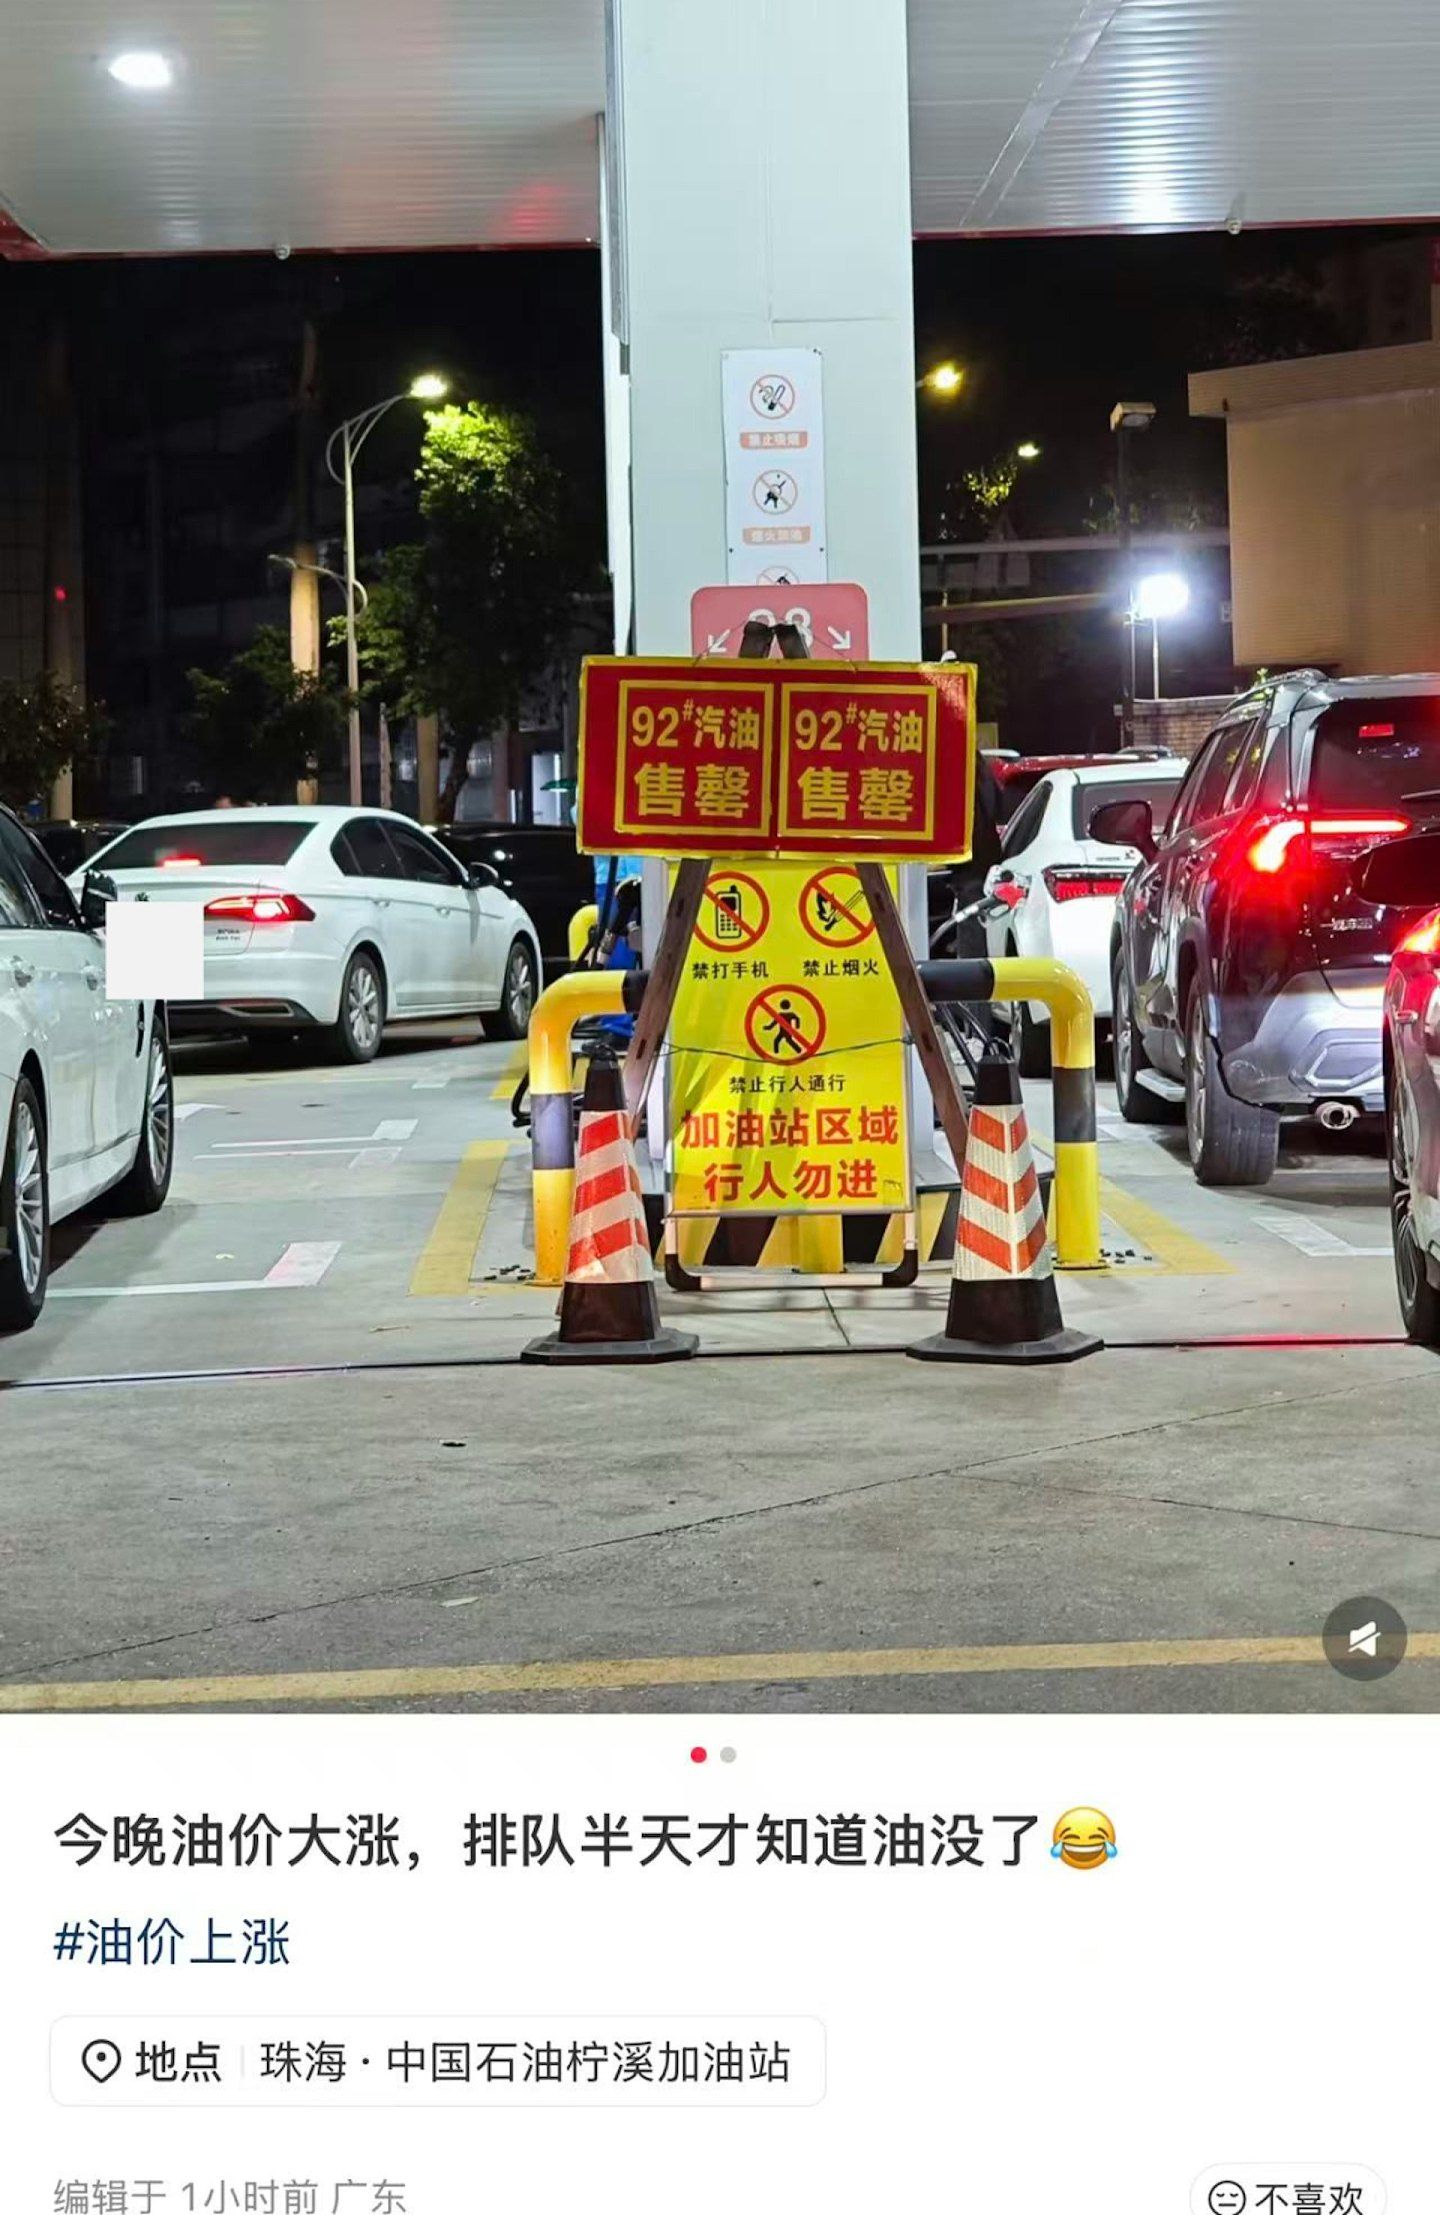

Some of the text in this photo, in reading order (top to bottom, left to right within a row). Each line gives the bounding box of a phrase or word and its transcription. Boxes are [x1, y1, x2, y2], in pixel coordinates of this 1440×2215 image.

[748, 607, 814, 657] 8
[631, 699, 760, 752] 92#汽油
[794, 701, 923, 755] 92#汽油
[633, 762, 750, 820] 售罄
[797, 766, 914, 823] 售罄
[691, 960, 770, 980] 禁打手机
[803, 958, 880, 978] 禁止烟火
[729, 1074, 847, 1094] 禁止行人通行
[681, 1106, 900, 1149] 加油站区域
[703, 1158, 879, 1202] 行人勿进
